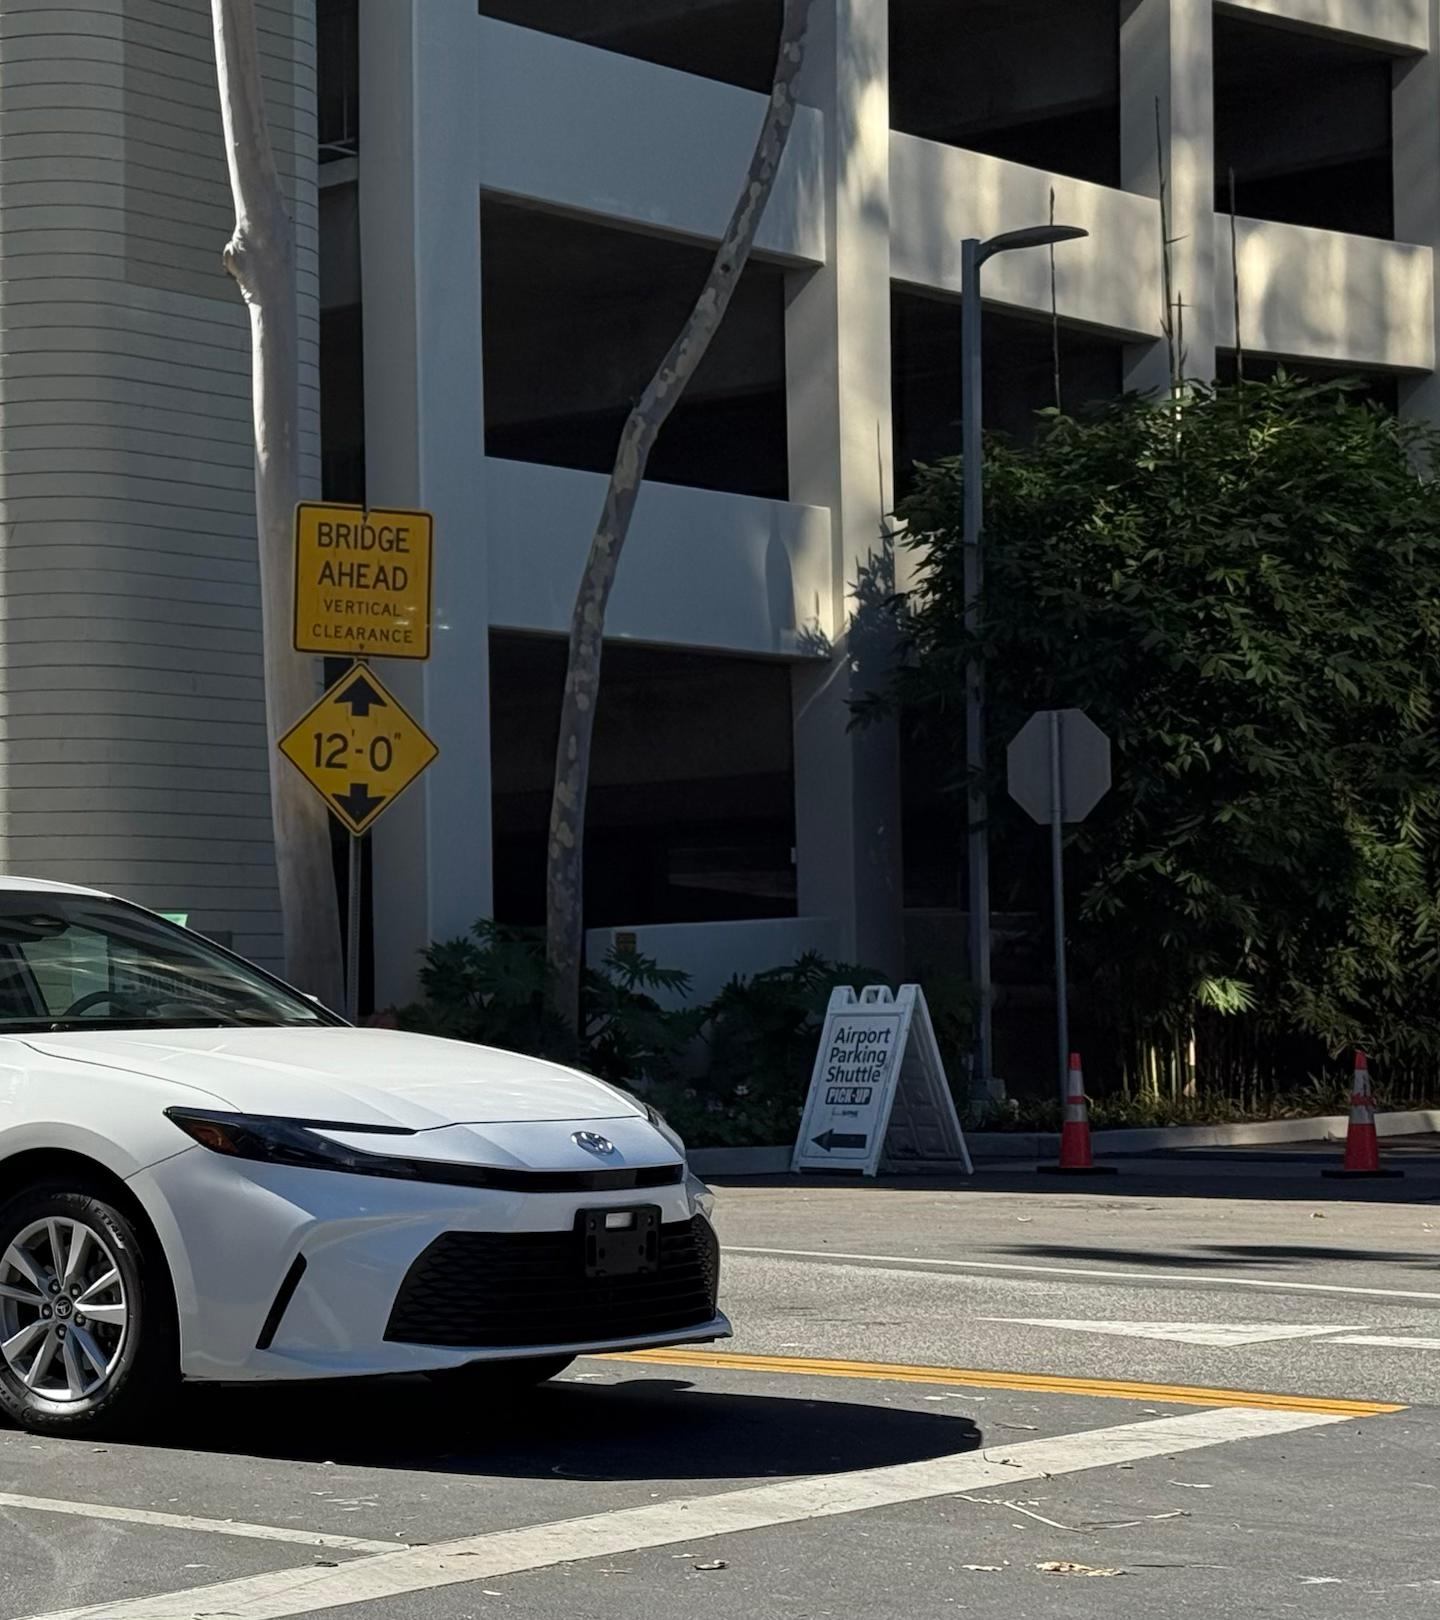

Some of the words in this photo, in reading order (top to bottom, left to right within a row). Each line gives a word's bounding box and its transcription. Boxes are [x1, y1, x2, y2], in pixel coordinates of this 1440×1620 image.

[318, 522, 410, 553] BRIDGE
[317, 560, 408, 591] AHEAD
[324, 599, 401, 617] VERTICAL
[312, 624, 413, 643] CLEARANCE
[834, 1026, 891, 1051] Airport
[829, 1045, 888, 1069] Parking
[826, 1066, 881, 1083] Shuttle
[827, 1088, 871, 1104] PICK-UP
